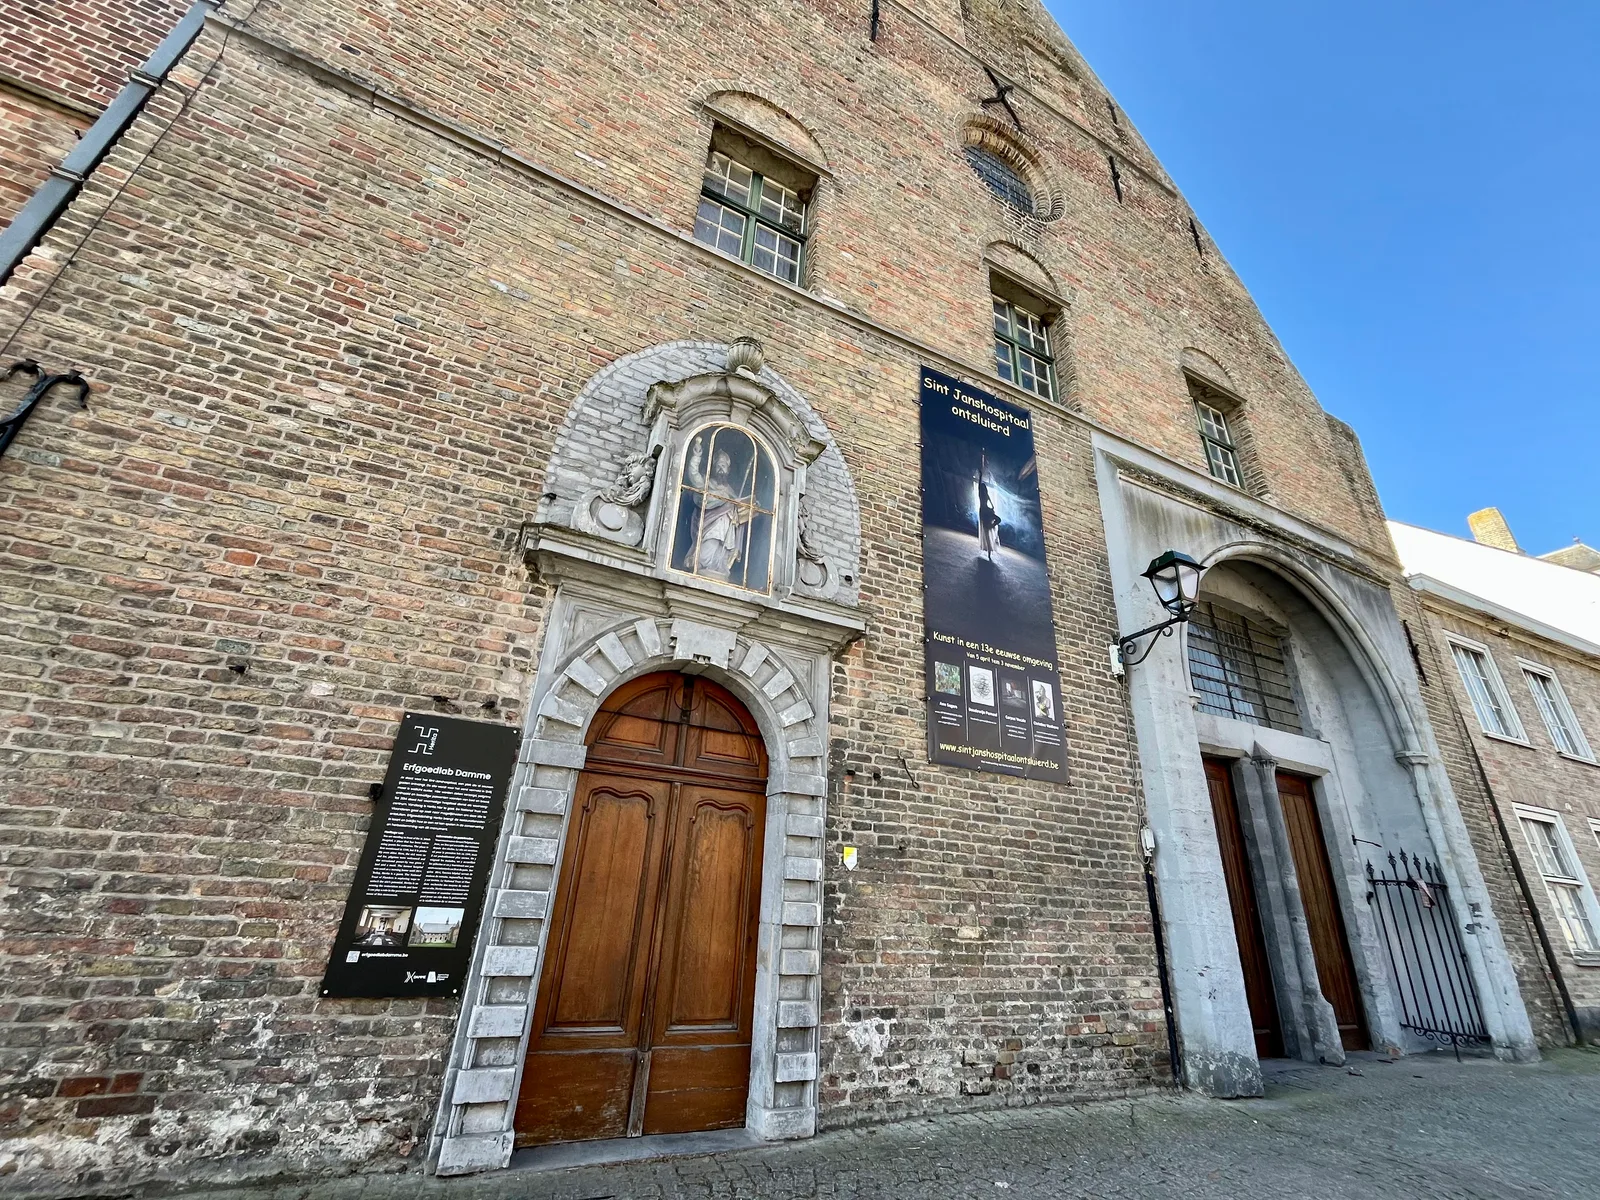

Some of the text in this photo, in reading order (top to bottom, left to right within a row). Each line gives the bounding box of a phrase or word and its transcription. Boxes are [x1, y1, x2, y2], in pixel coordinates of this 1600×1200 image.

[923, 377, 1029, 430] Sint Janshospitaal
[951, 406, 1010, 437] ontsluierd
[933, 631, 1053, 671] Kunst in een 13e eeuwse omgeving
[1004, 662, 1026, 671] november
[939, 742, 1059, 770] www.sintjanshospitaalontsluierd.be
[403, 763, 492, 780] Erfgoedlab Damme
